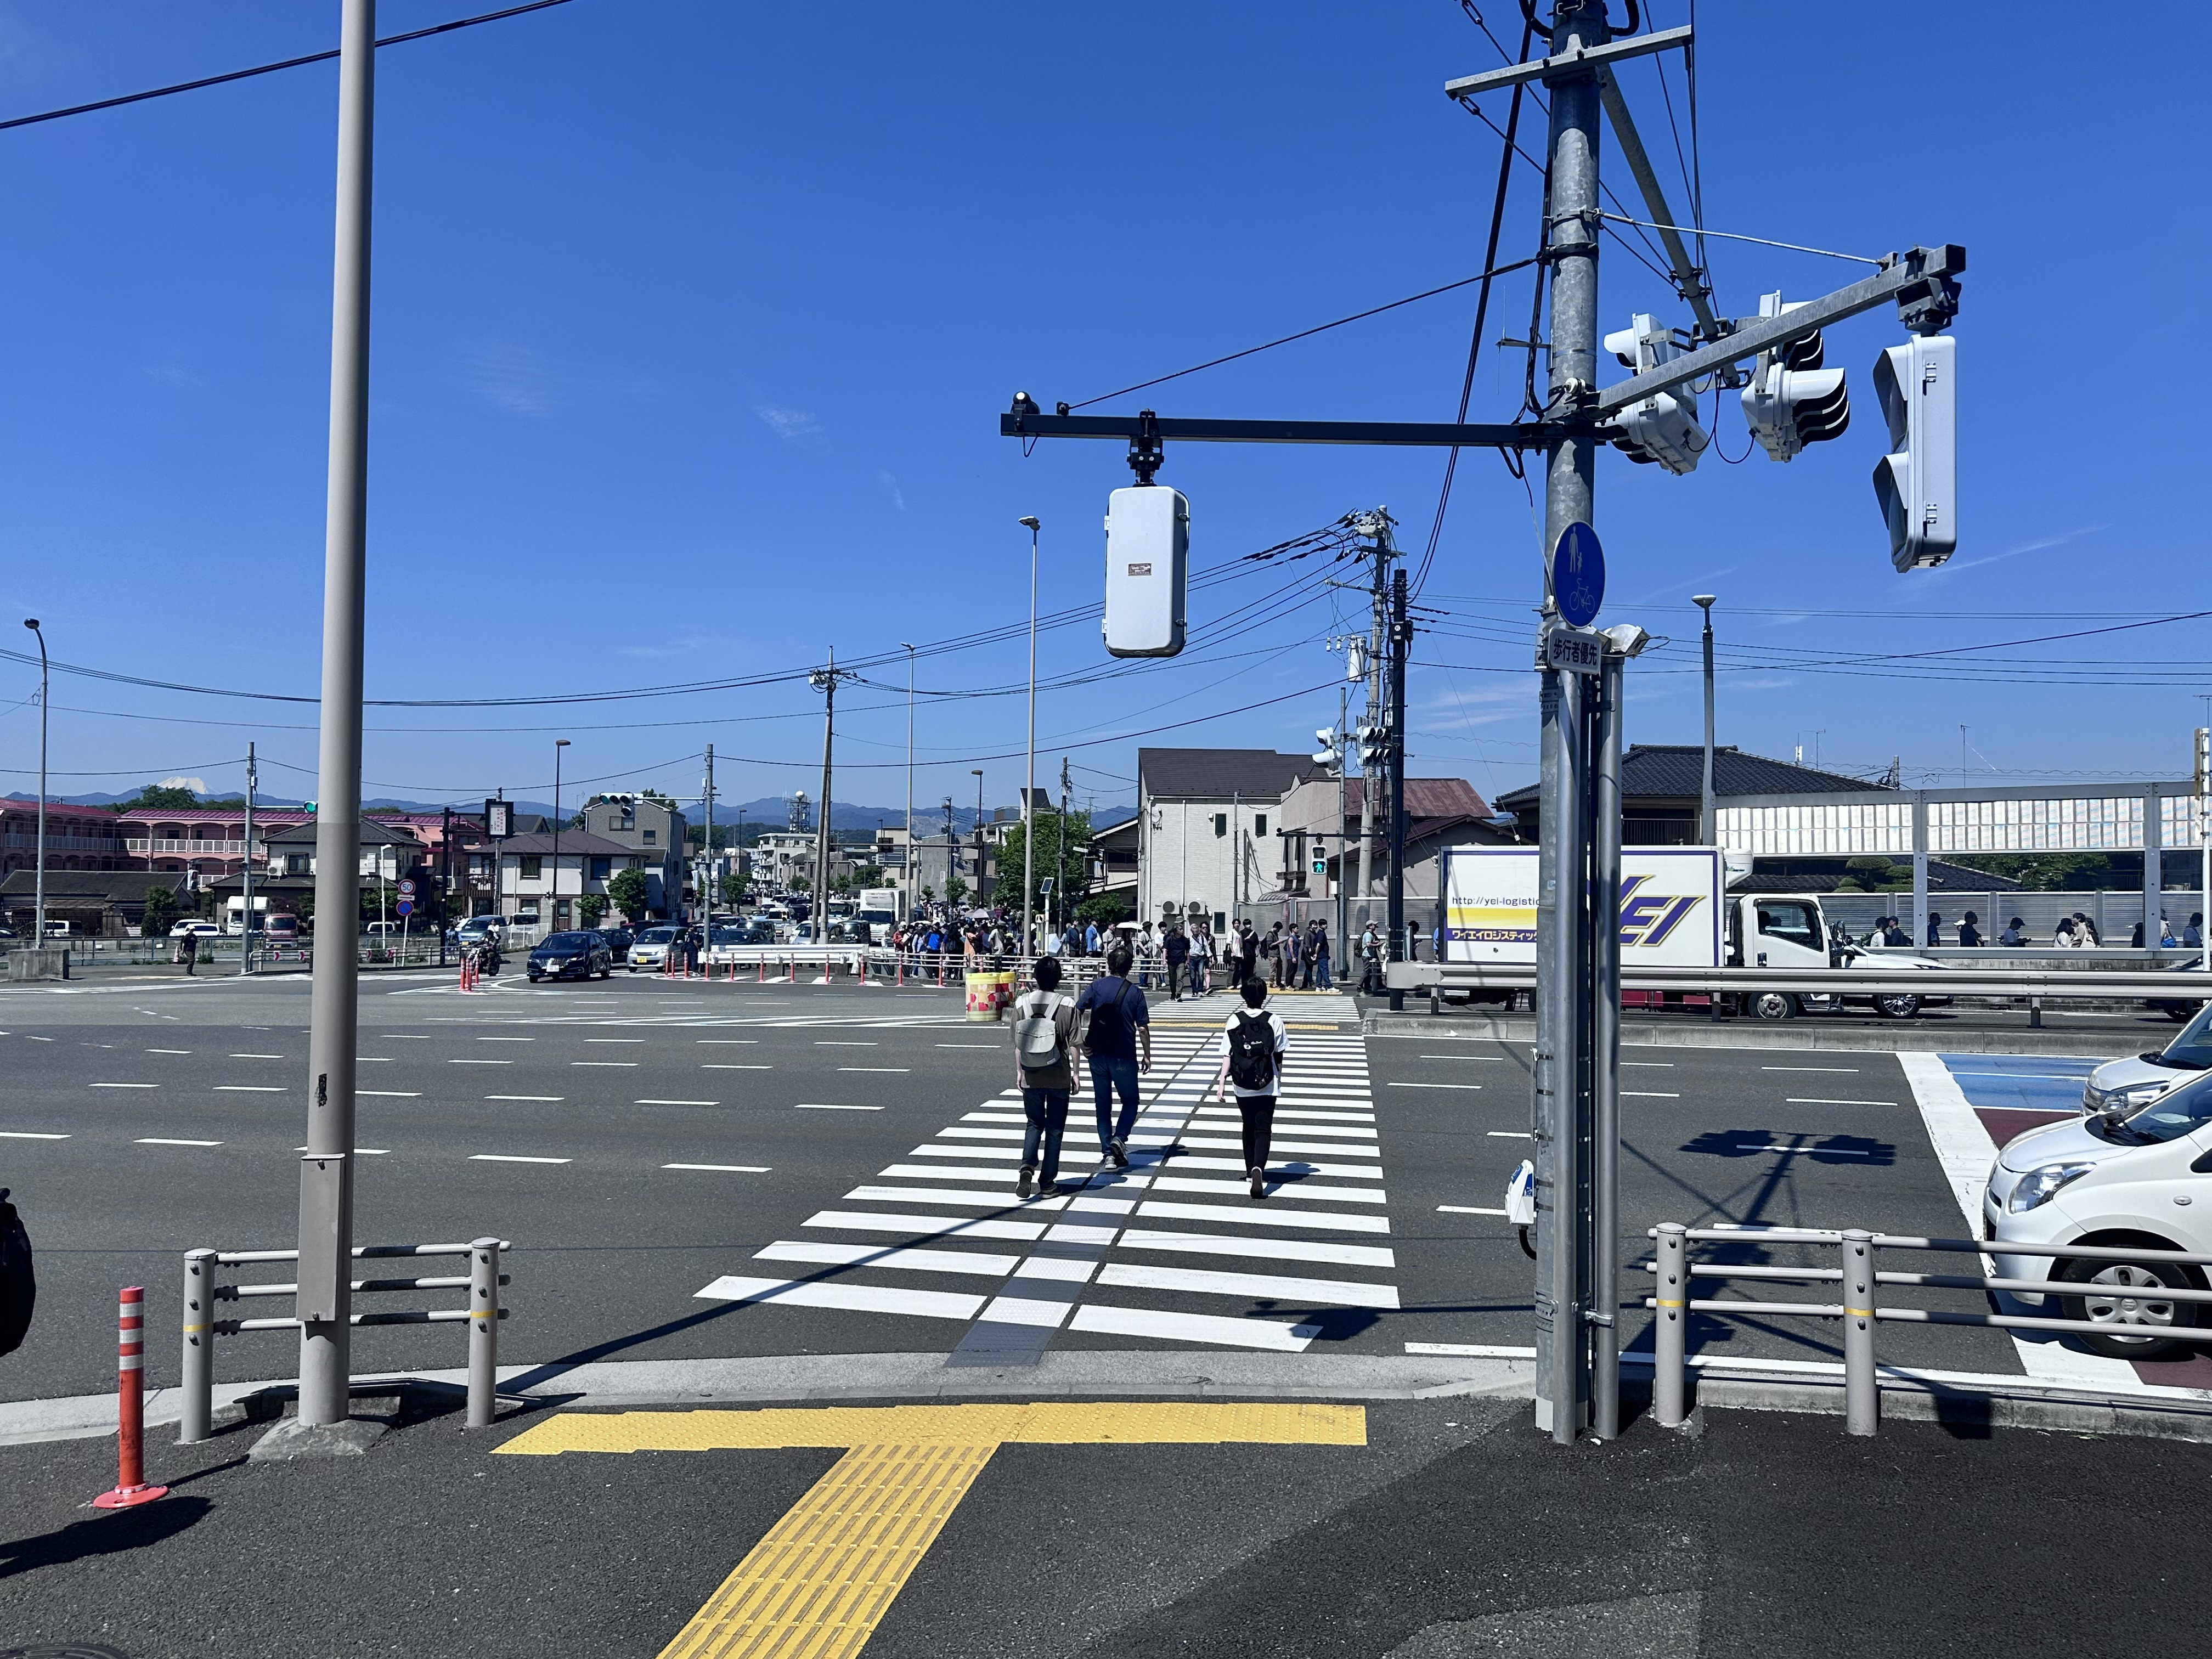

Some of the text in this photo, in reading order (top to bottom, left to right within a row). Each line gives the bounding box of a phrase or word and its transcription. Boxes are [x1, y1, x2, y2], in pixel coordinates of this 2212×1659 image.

[1553, 637, 1598, 666] 歩行者優先
